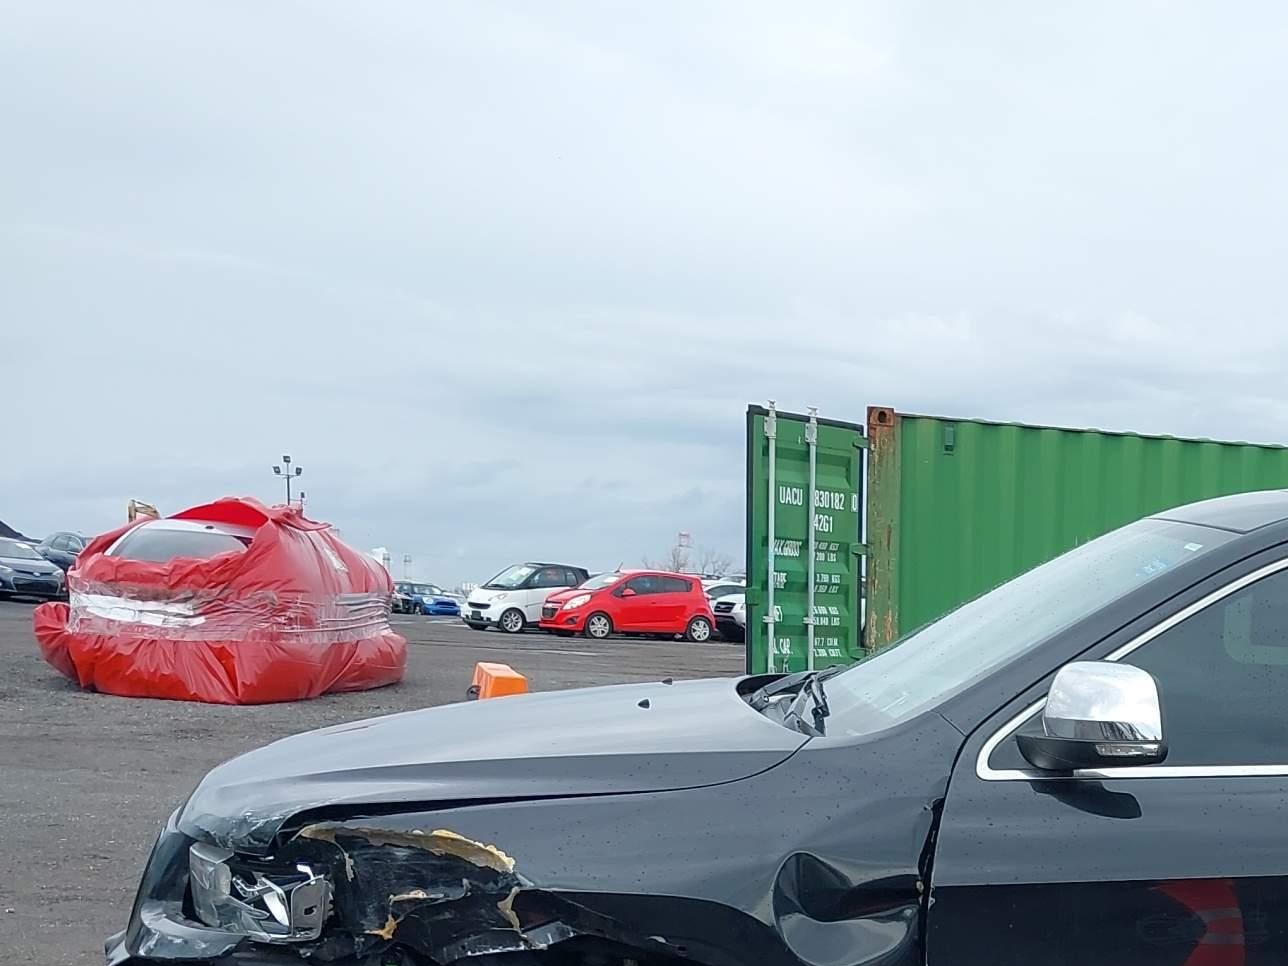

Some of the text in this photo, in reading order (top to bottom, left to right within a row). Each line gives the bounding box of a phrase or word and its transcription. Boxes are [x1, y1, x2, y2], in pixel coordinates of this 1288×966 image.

[779, 485, 803, 506] UACU
[814, 489, 845, 510] 830182
[813, 513, 833, 533] 42G1
